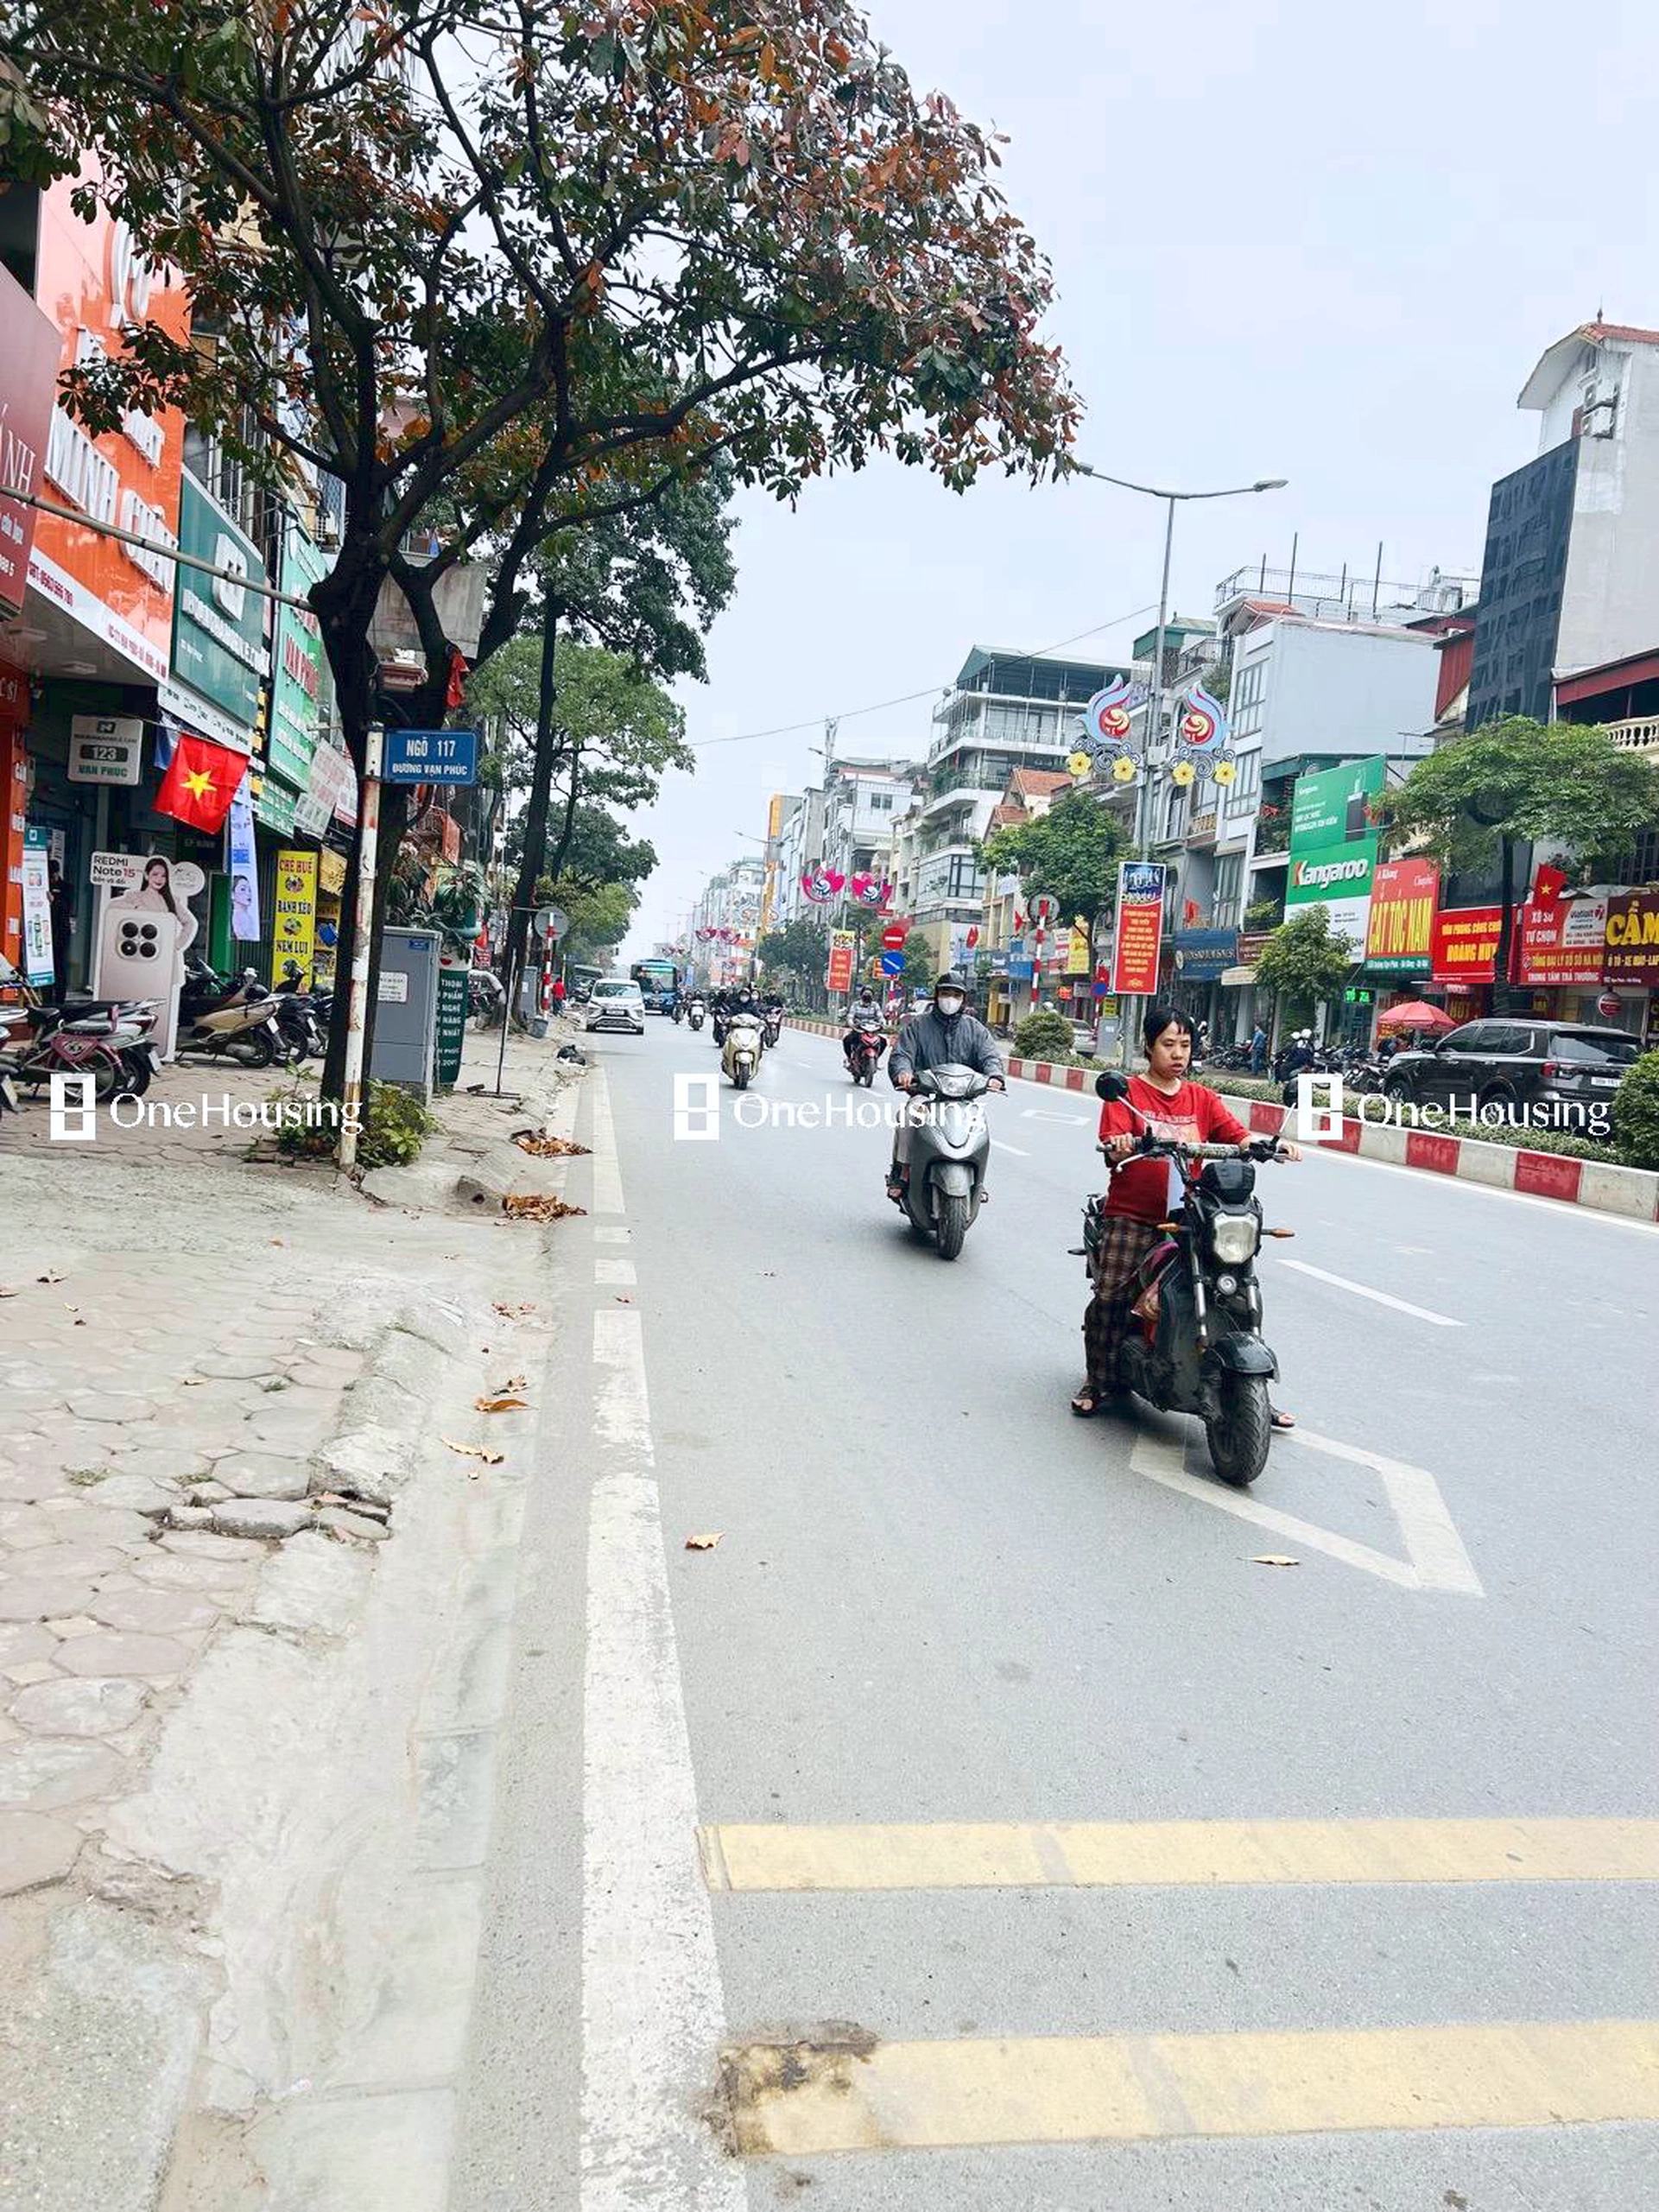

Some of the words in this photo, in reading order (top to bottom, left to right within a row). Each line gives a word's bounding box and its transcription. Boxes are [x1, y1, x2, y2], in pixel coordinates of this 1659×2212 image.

[92, 746, 117, 760] 123
[406, 737, 428, 757] NGÕ
[437, 739, 456, 757] 117
[392, 760, 421, 774] ĐƯỜNG
[424, 764, 442, 776] VẠN
[443, 763, 468, 775] PHÚC
[92, 855, 129, 866] REDMI
[92, 865, 122, 876] Note
[123, 868, 136, 878] 15
[1292, 859, 1369, 890] Kangaroo
[1407, 897, 1434, 954] NAM
[1536, 930, 1557, 946] CHỌN
